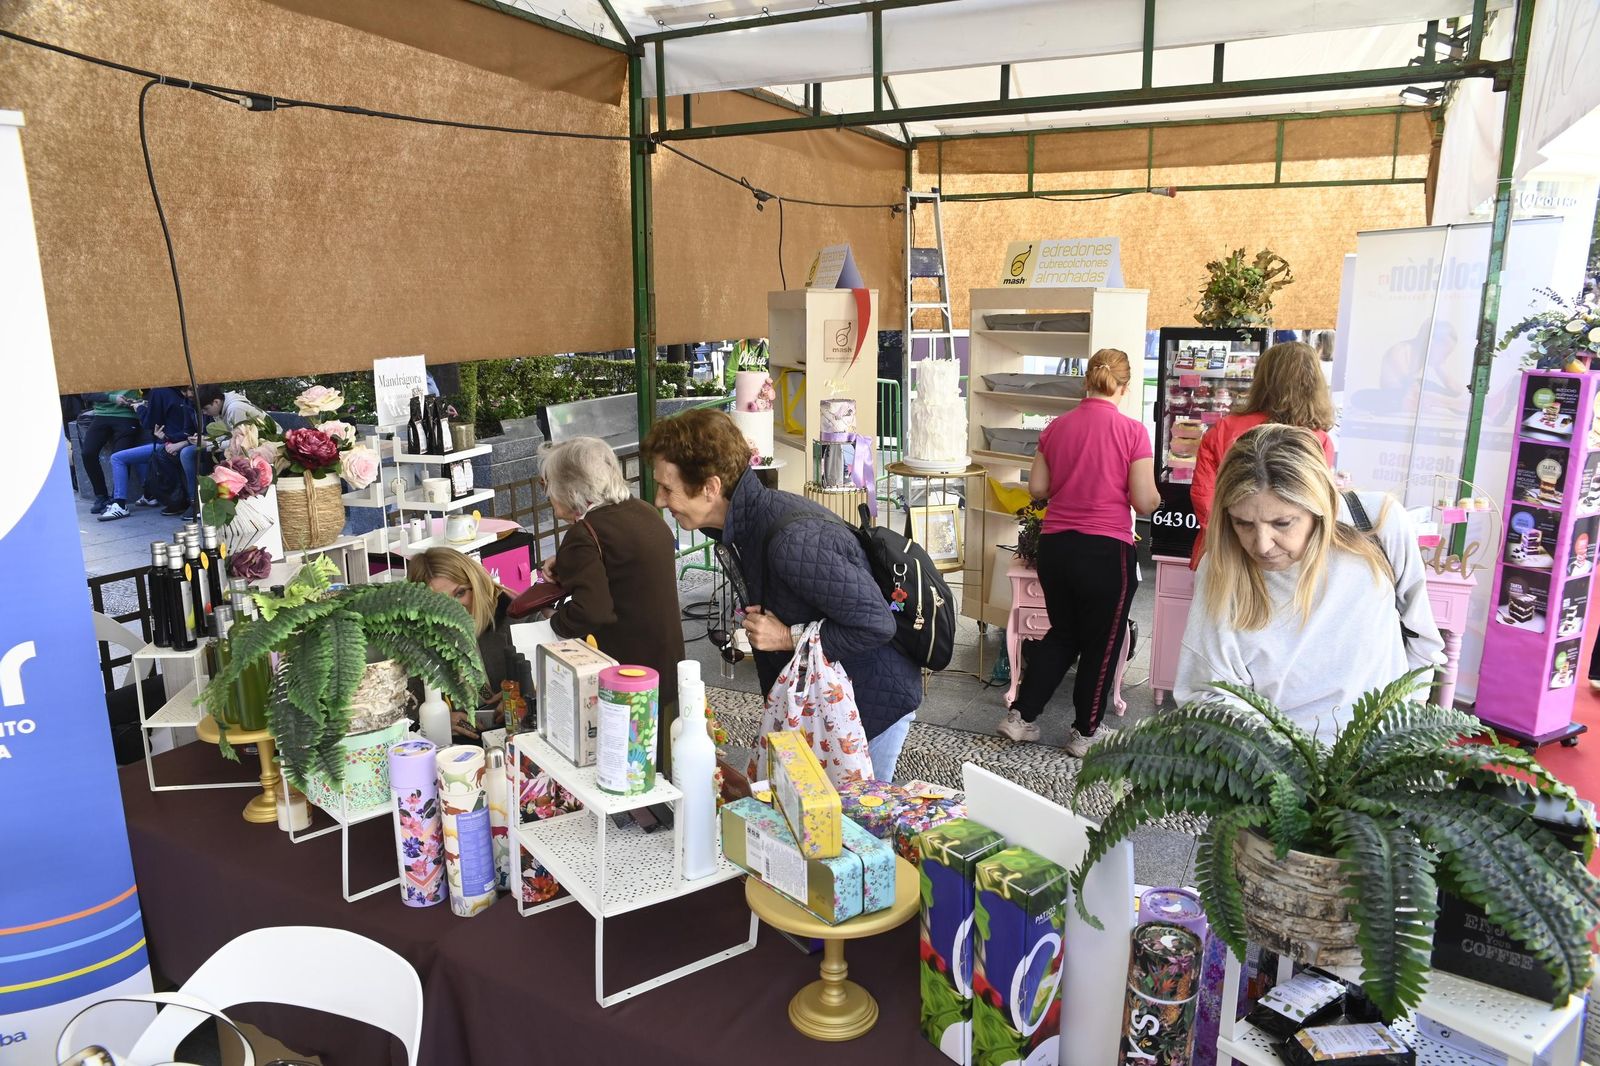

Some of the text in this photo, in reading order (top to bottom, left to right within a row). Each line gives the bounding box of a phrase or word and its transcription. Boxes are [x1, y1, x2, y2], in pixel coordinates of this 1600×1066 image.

[1042, 243, 1112, 257] edredones
[1039, 258, 1108, 269] cubrecolchones
[1003, 277, 1025, 285] mash
[1035, 270, 1105, 284] almohadas
[378, 372, 422, 389] Mandrágora
[0, 640, 37, 707] r
[1461, 938, 1533, 970] COFFEE
